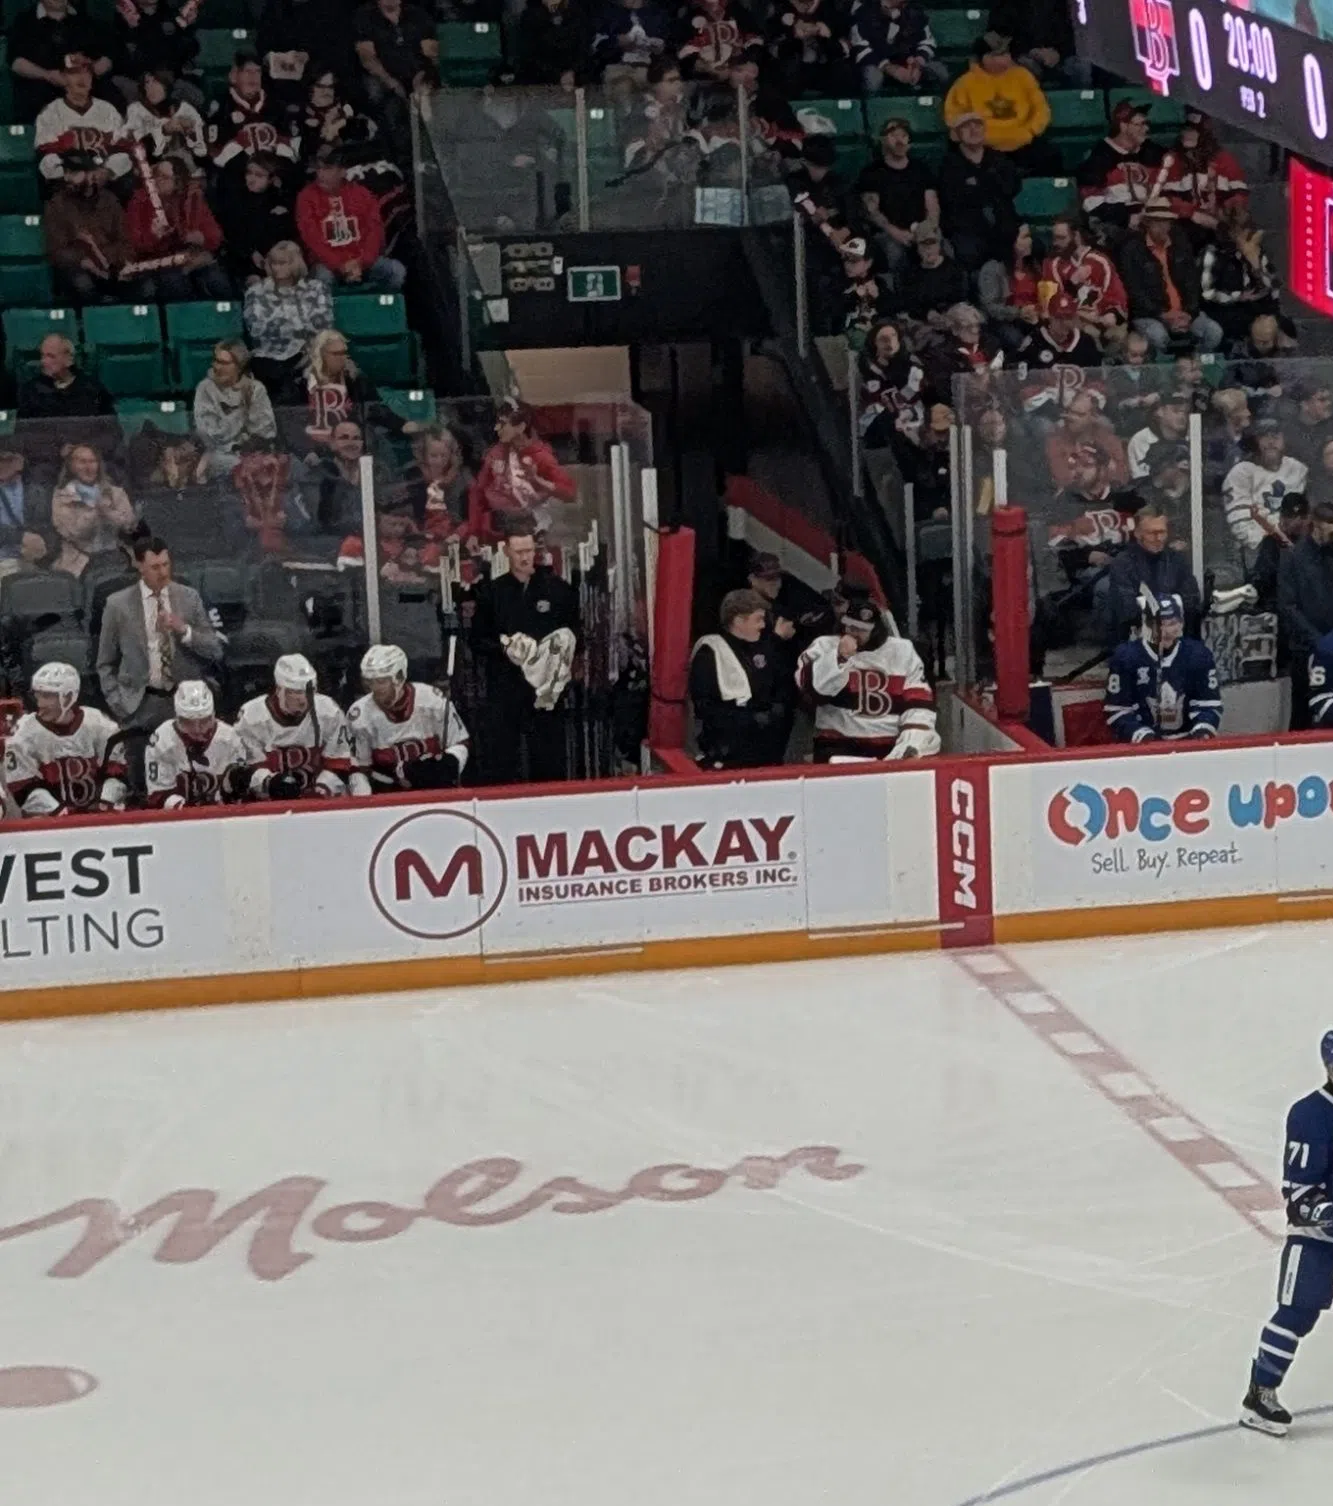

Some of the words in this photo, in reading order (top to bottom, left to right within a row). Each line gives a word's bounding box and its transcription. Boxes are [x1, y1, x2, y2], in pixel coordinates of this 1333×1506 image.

[1189, 8, 1212, 91] 0
[1223, 12, 1277, 83] 20:00
[1304, 53, 1327, 139] 0
[950, 778, 976, 910] CCM
[1046, 781, 1211, 846] Once
[395, 845, 483, 900] M
[516, 816, 795, 880] MACKAY
[519, 879, 641, 902] INSURANCE
[649, 870, 747, 892] BROKERS
[756, 867, 797, 885] INC.
[1288, 1141, 1309, 1168] 71
[0, 1146, 864, 1281] Molson
